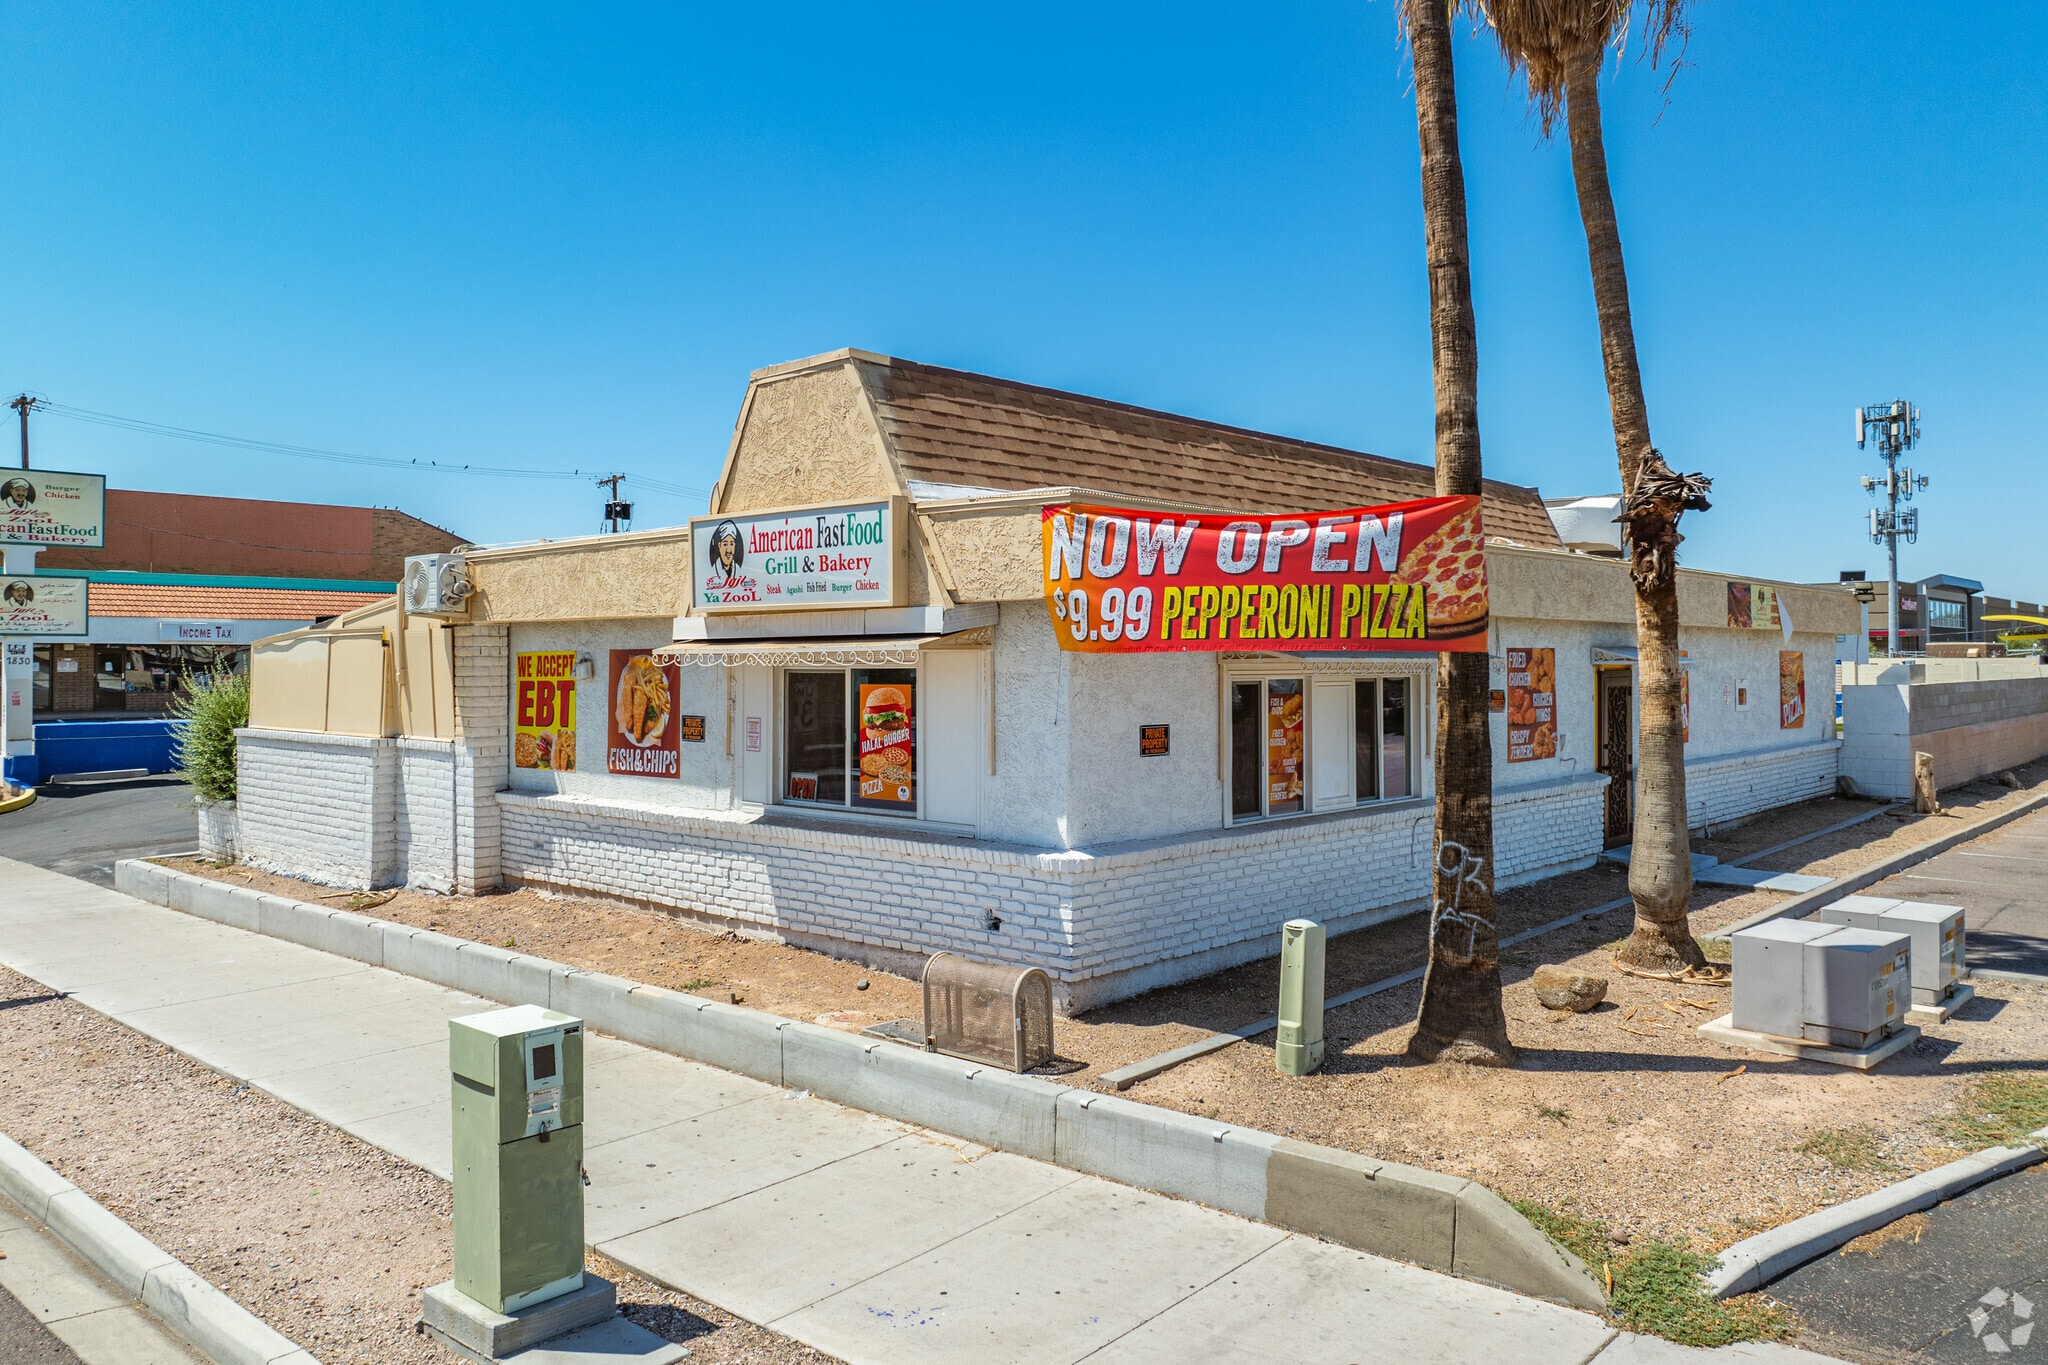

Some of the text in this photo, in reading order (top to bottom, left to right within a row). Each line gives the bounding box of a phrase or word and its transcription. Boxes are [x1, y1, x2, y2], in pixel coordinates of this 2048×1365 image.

[44, 492, 80, 500] Chicken
[45, 484, 80, 492] Burger
[28, 534, 88, 544] Bakery
[748, 518, 813, 554] American
[1050, 512, 1404, 580] NOW OPEN
[765, 553, 872, 576] Grill & Bakery
[766, 583, 782, 594] Steak
[786, 584, 803, 595] Agashi
[831, 583, 852, 594] Burger
[855, 579, 879, 591] Chicken
[704, 593, 720, 603] Ya
[1055, 583, 1426, 642] $9.99 PEPPERONI PIZZA
[6, 657, 30, 665] 1830
[517, 654, 575, 678] WE ACCEPT
[1508, 652, 1526, 668] FRIED
[1509, 672, 1531, 687] CHICKEN
[517, 680, 575, 728] EBT
[861, 727, 910, 754] HALAL BURGER
[1145, 728, 1165, 738] PRIVATE
[1510, 729, 1530, 744] CRISPY
[1142, 738, 1168, 749] PROPERTY
[790, 777, 816, 799] OPEN
[861, 778, 884, 797] PIZZA
